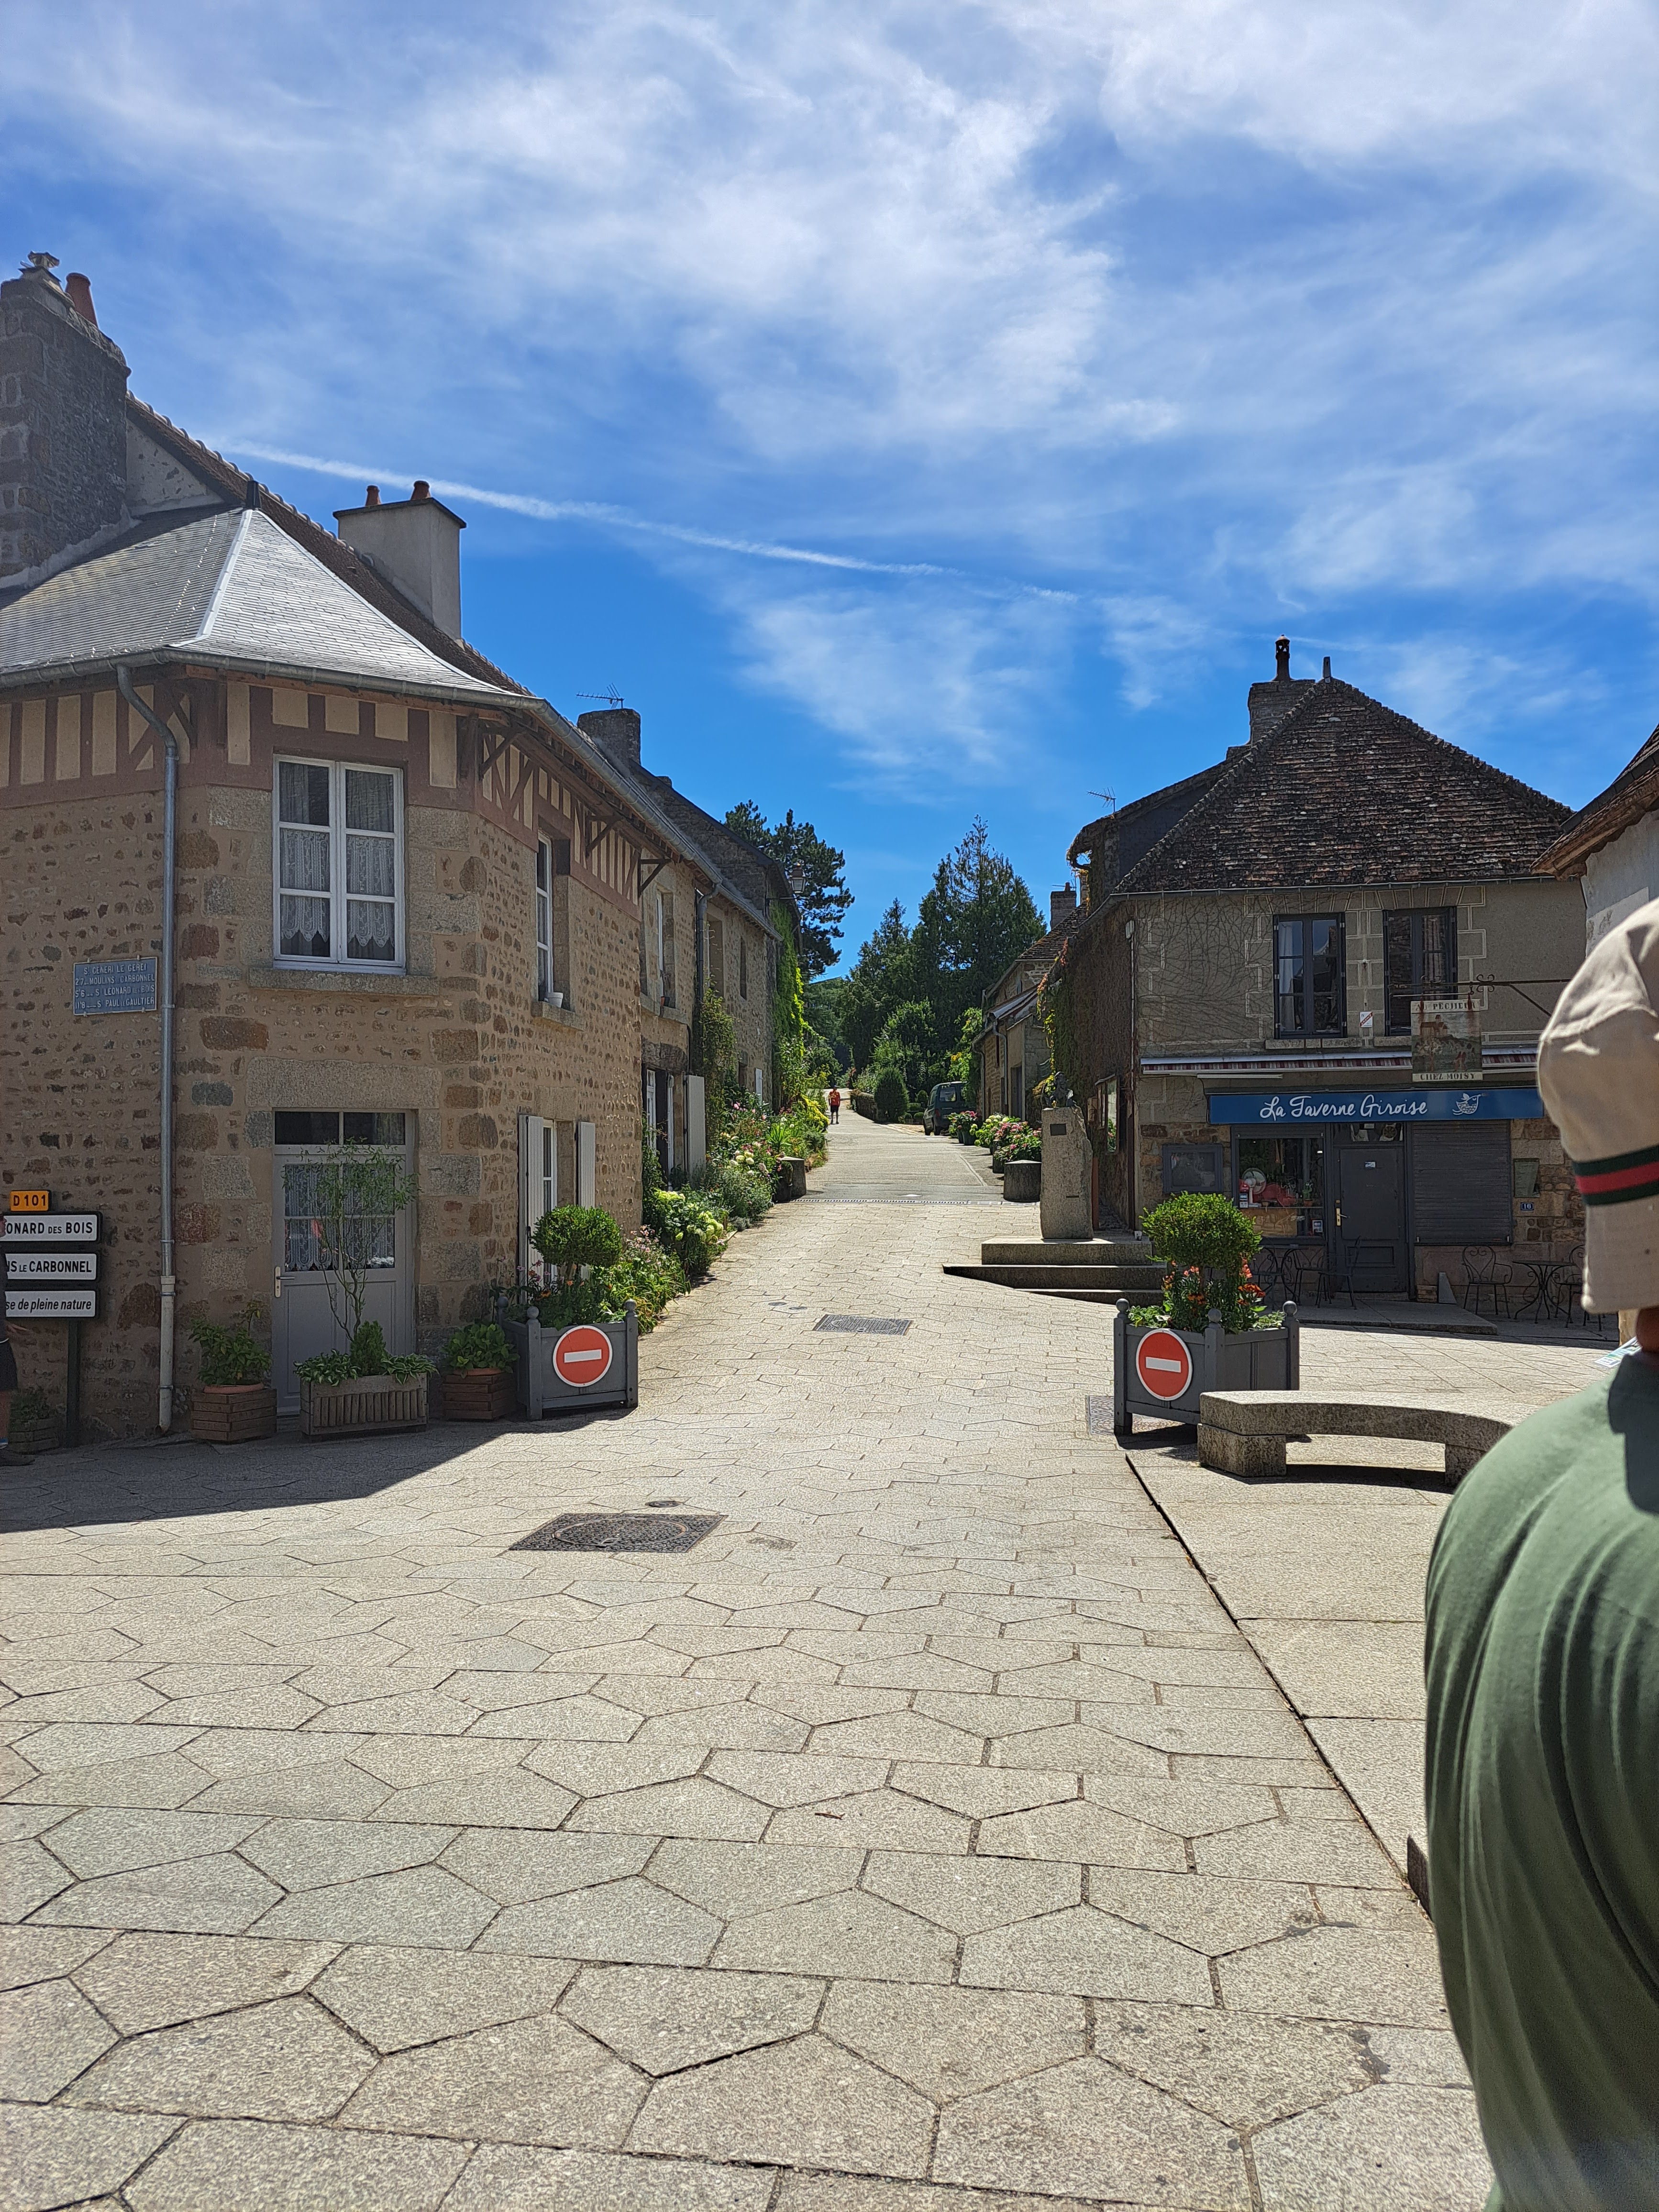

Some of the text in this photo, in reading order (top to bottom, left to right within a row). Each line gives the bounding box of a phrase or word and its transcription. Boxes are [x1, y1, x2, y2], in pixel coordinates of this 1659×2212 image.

[117, 964, 125, 973] LE
[128, 963, 146, 972] GEREI
[89, 976, 115, 985] MOULINS
[120, 973, 155, 983] CARBONNEL
[104, 986, 131, 995] LEONARD
[141, 984, 155, 993] BOIS
[105, 999, 120, 1007] PAUL
[126, 996, 155, 1006] GAULTIER
[1260, 1094, 1427, 1121] La Taverne Giroise
[13, 1194, 45, 1206] D 101
[6, 1222, 44, 1234] ONARD
[66, 1222, 93, 1234] BOIS
[19, 1264, 27, 1272] LE
[29, 1261, 92, 1272] CARBONNEL
[18, 1298, 29, 1310] de
[30, 1298, 59, 1313] pleine
[60, 1299, 92, 1310] nature
